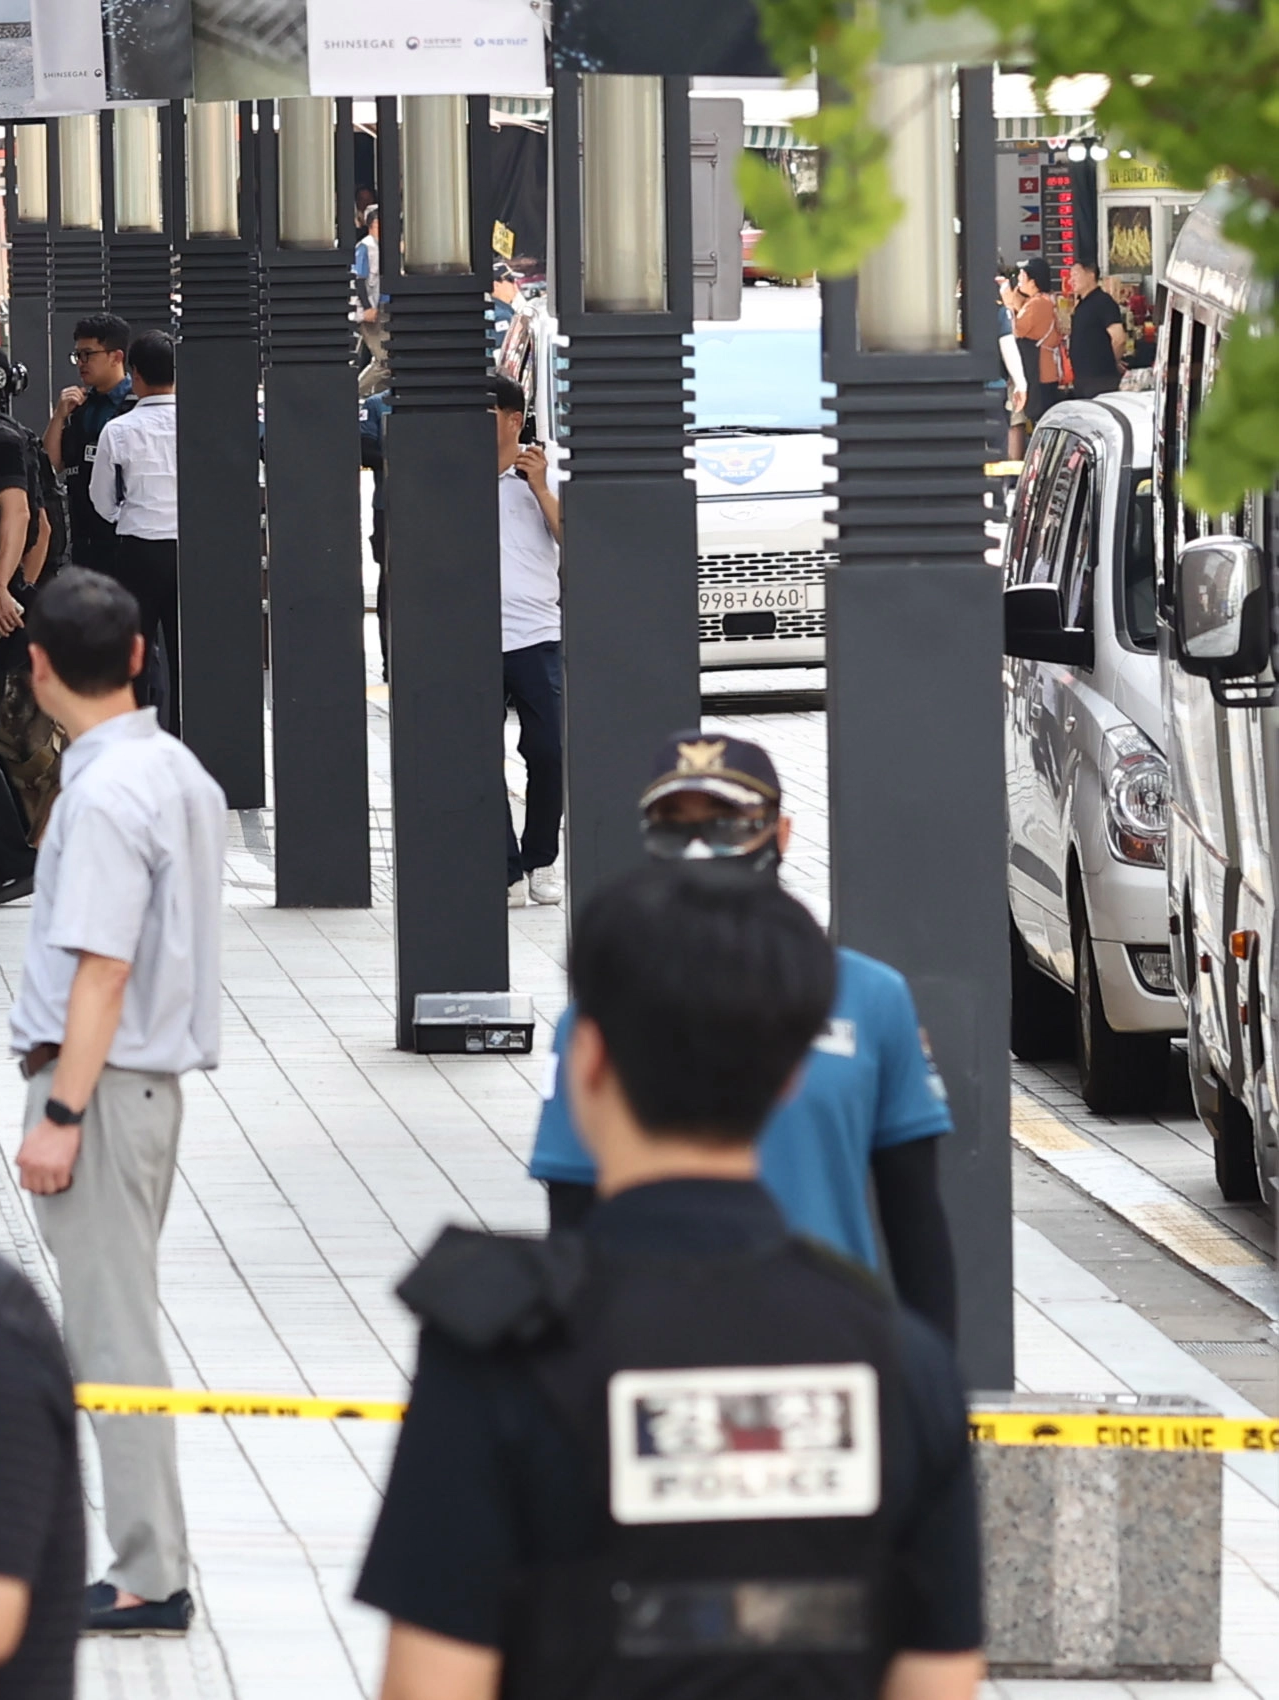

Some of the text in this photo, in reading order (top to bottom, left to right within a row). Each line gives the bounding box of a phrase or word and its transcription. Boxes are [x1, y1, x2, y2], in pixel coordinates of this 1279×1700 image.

[324, 38, 395, 50] SHINSEGAE
[43, 69, 88, 79] SHINSEGAE
[699, 588, 799, 610] 998구 6660
[650, 1467, 841, 1501] POLICE
